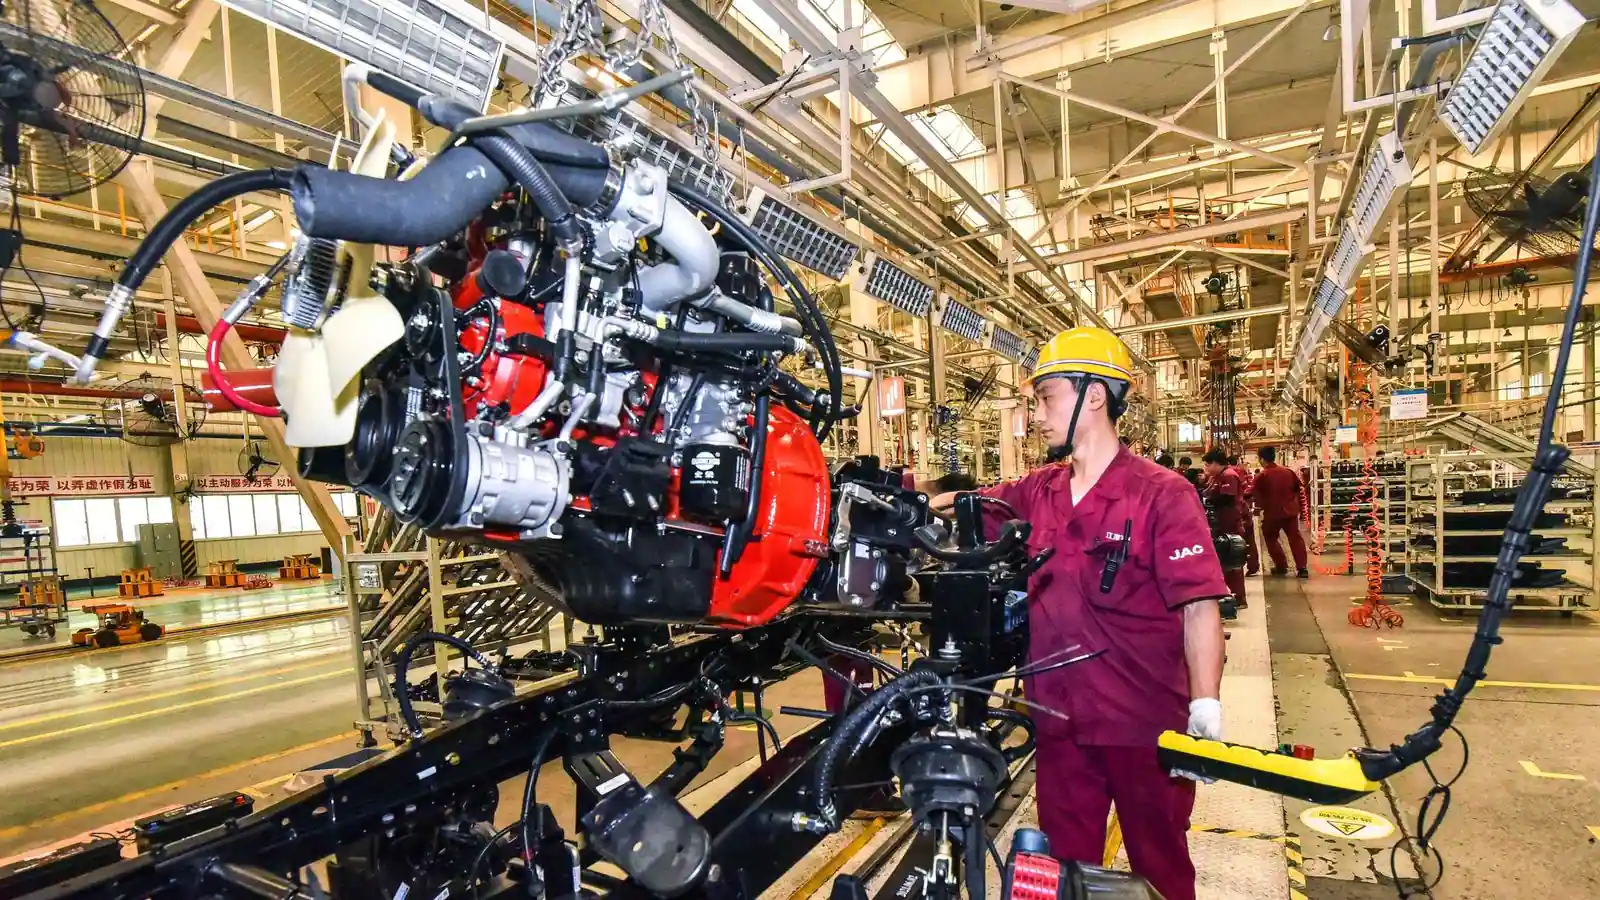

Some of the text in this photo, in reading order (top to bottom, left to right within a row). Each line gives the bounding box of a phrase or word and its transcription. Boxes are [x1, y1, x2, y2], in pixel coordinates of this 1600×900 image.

[57, 479, 152, 491] 以弄虚作假为耻
[197, 477, 272, 488] 以主动服务为荣
[1169, 544, 1204, 561] JAC
